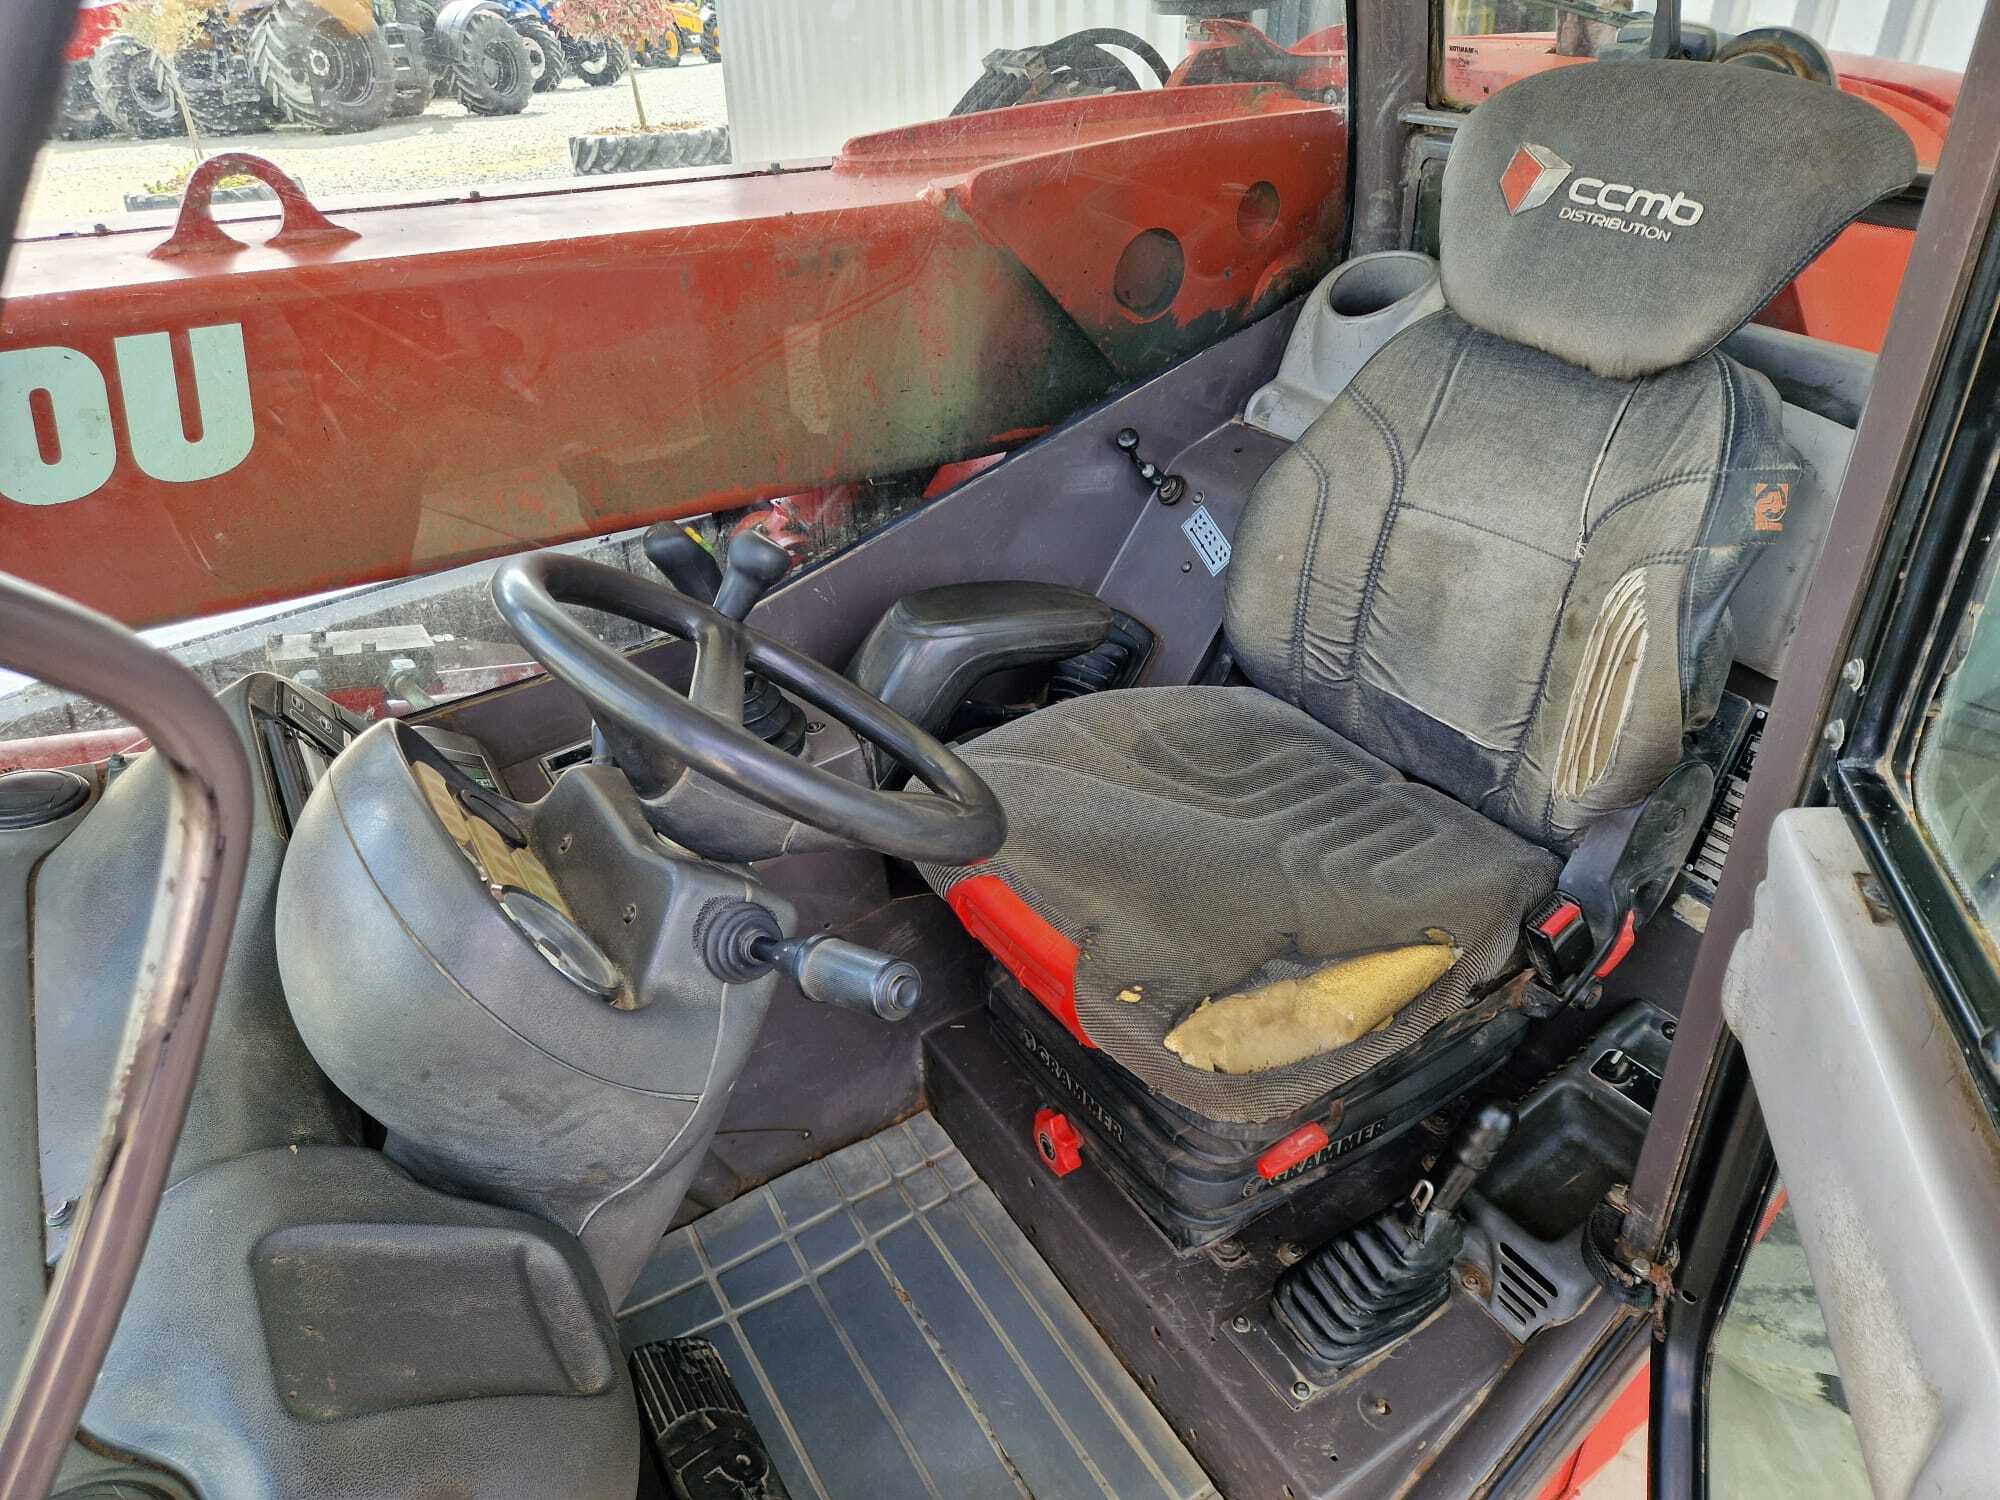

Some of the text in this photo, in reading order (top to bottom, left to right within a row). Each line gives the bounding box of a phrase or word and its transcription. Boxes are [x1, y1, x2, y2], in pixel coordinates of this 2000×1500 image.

[1558, 207, 1672, 242] DISTRIBUTION
[1568, 177, 1704, 226] ccmb
[0, 322, 255, 506] OU
[1039, 1046, 1123, 1143] GRAMMER
